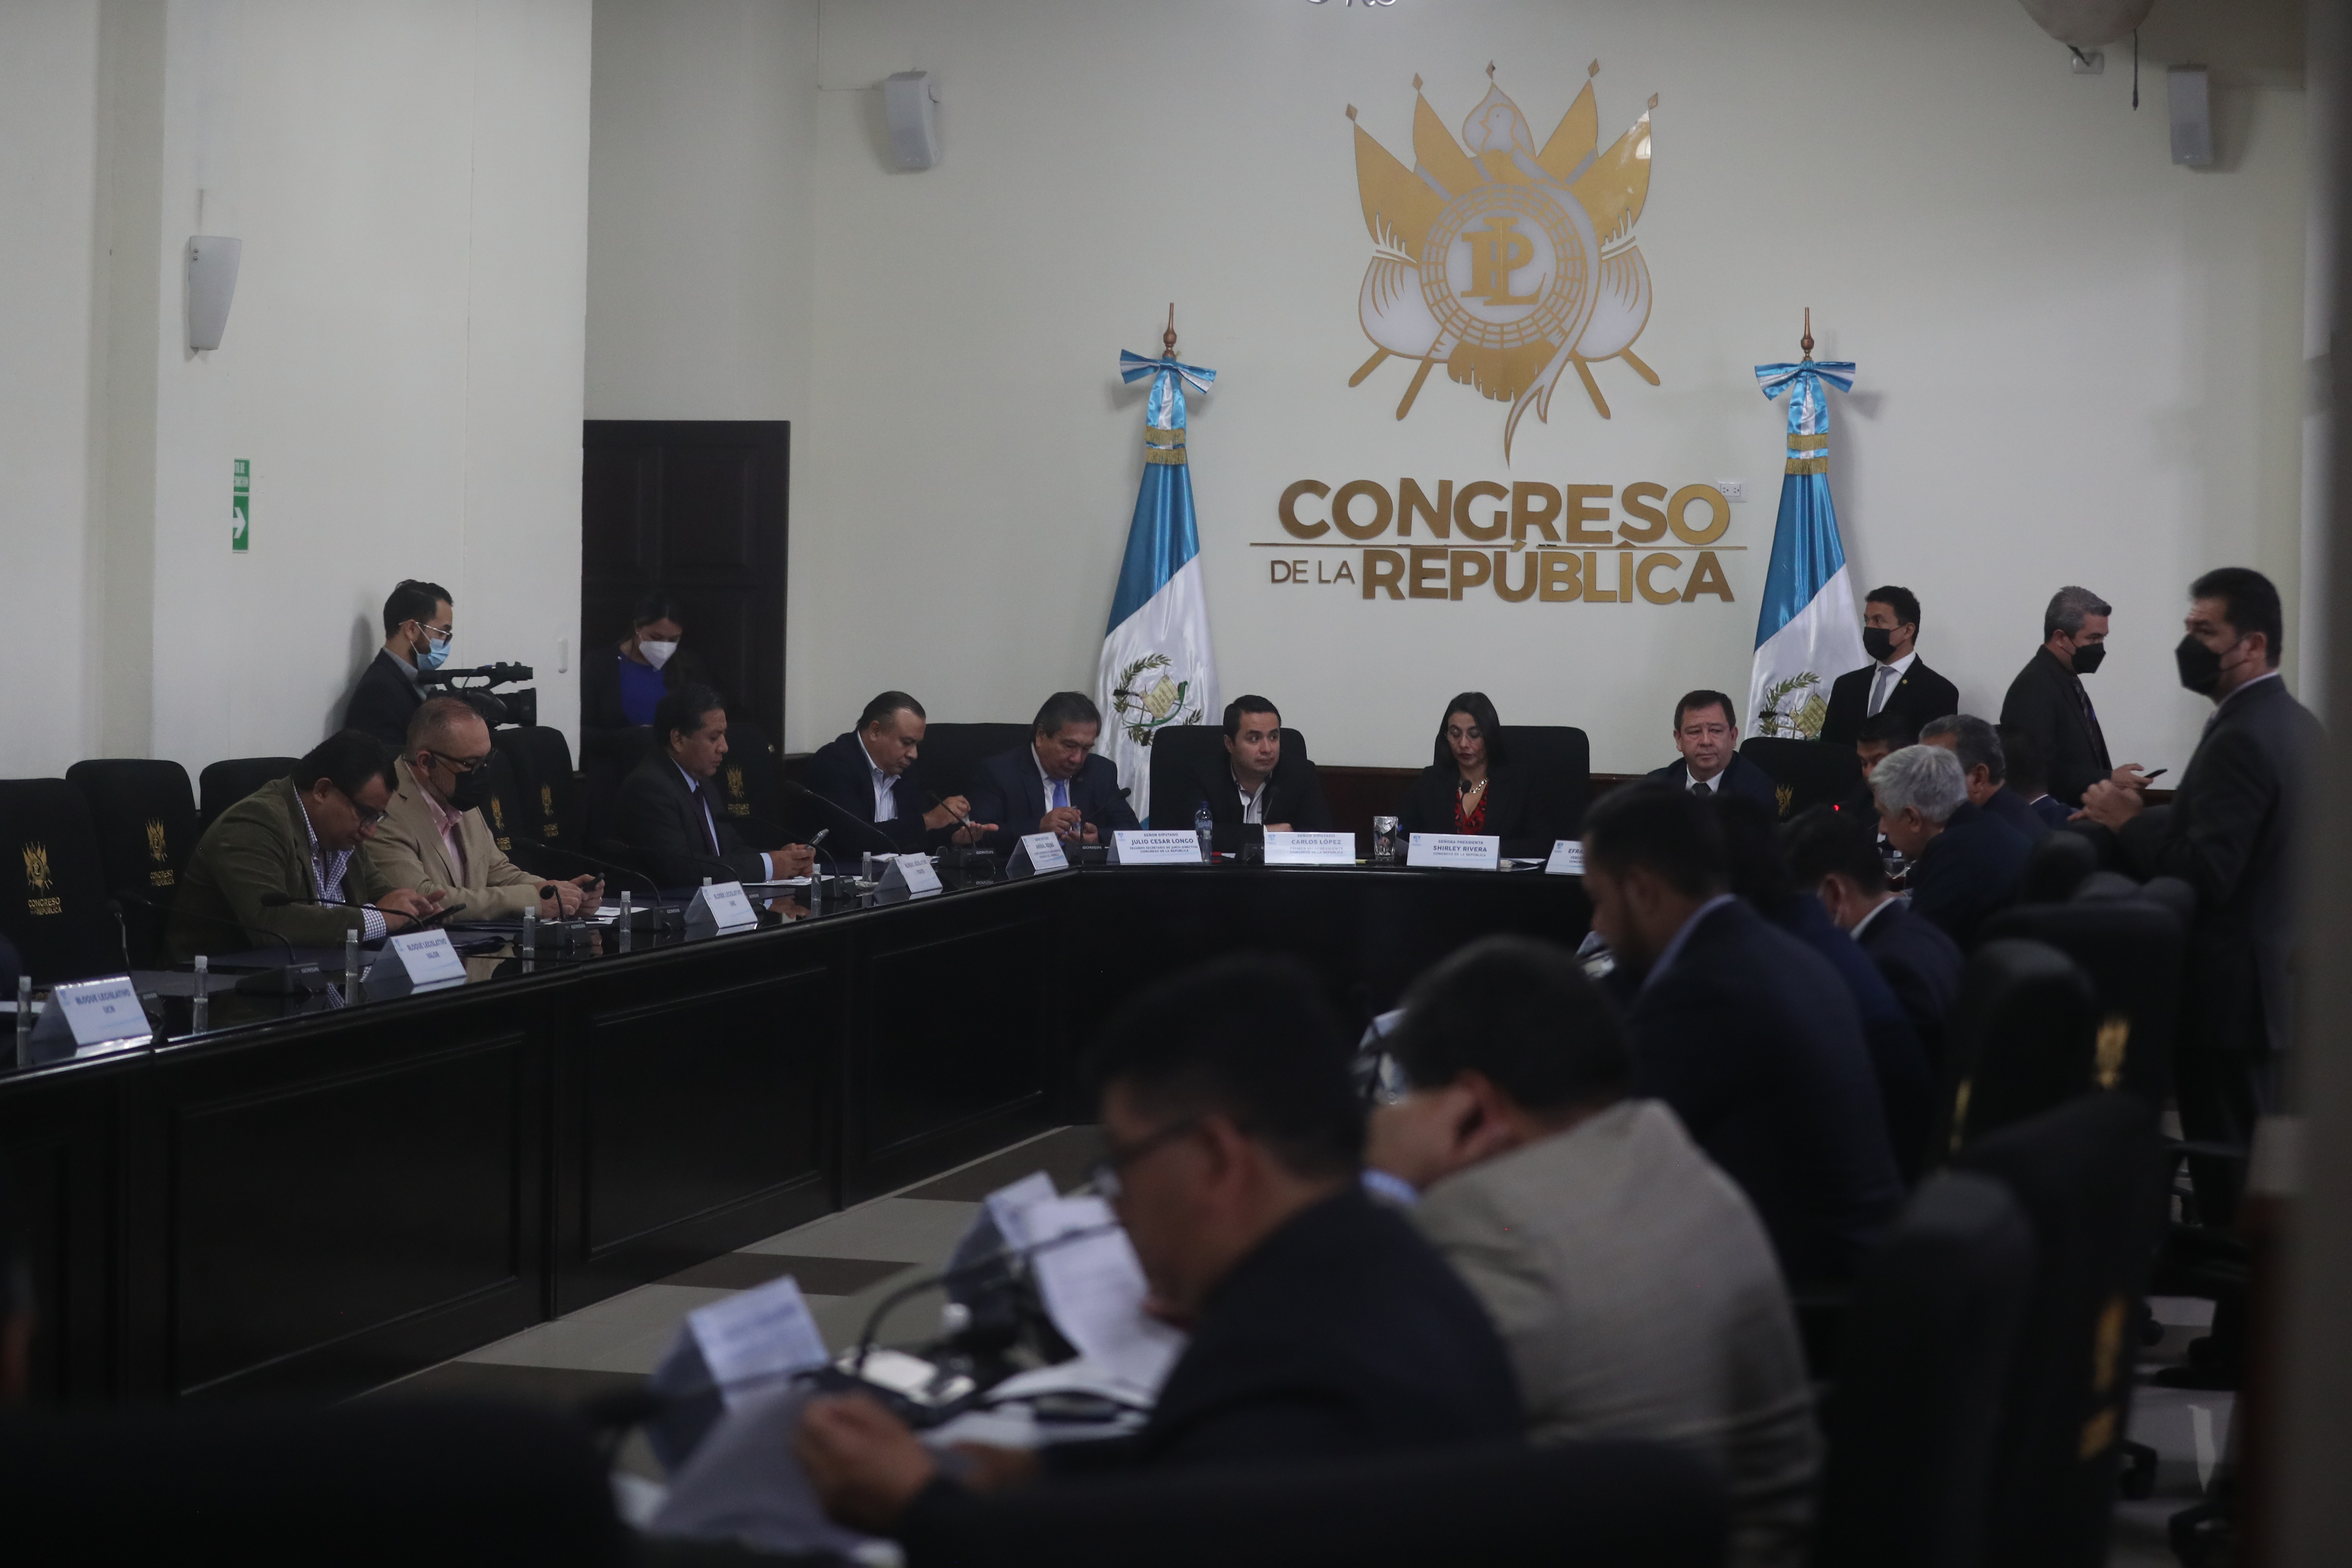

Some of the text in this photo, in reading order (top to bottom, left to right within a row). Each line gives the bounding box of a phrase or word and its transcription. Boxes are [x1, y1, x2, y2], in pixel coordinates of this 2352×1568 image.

[1278, 478, 1730, 545] CONGRESO
[1271, 540, 1735, 605] DE LA REPÚBLICA
[28, 897, 60, 908] CONGRESO
